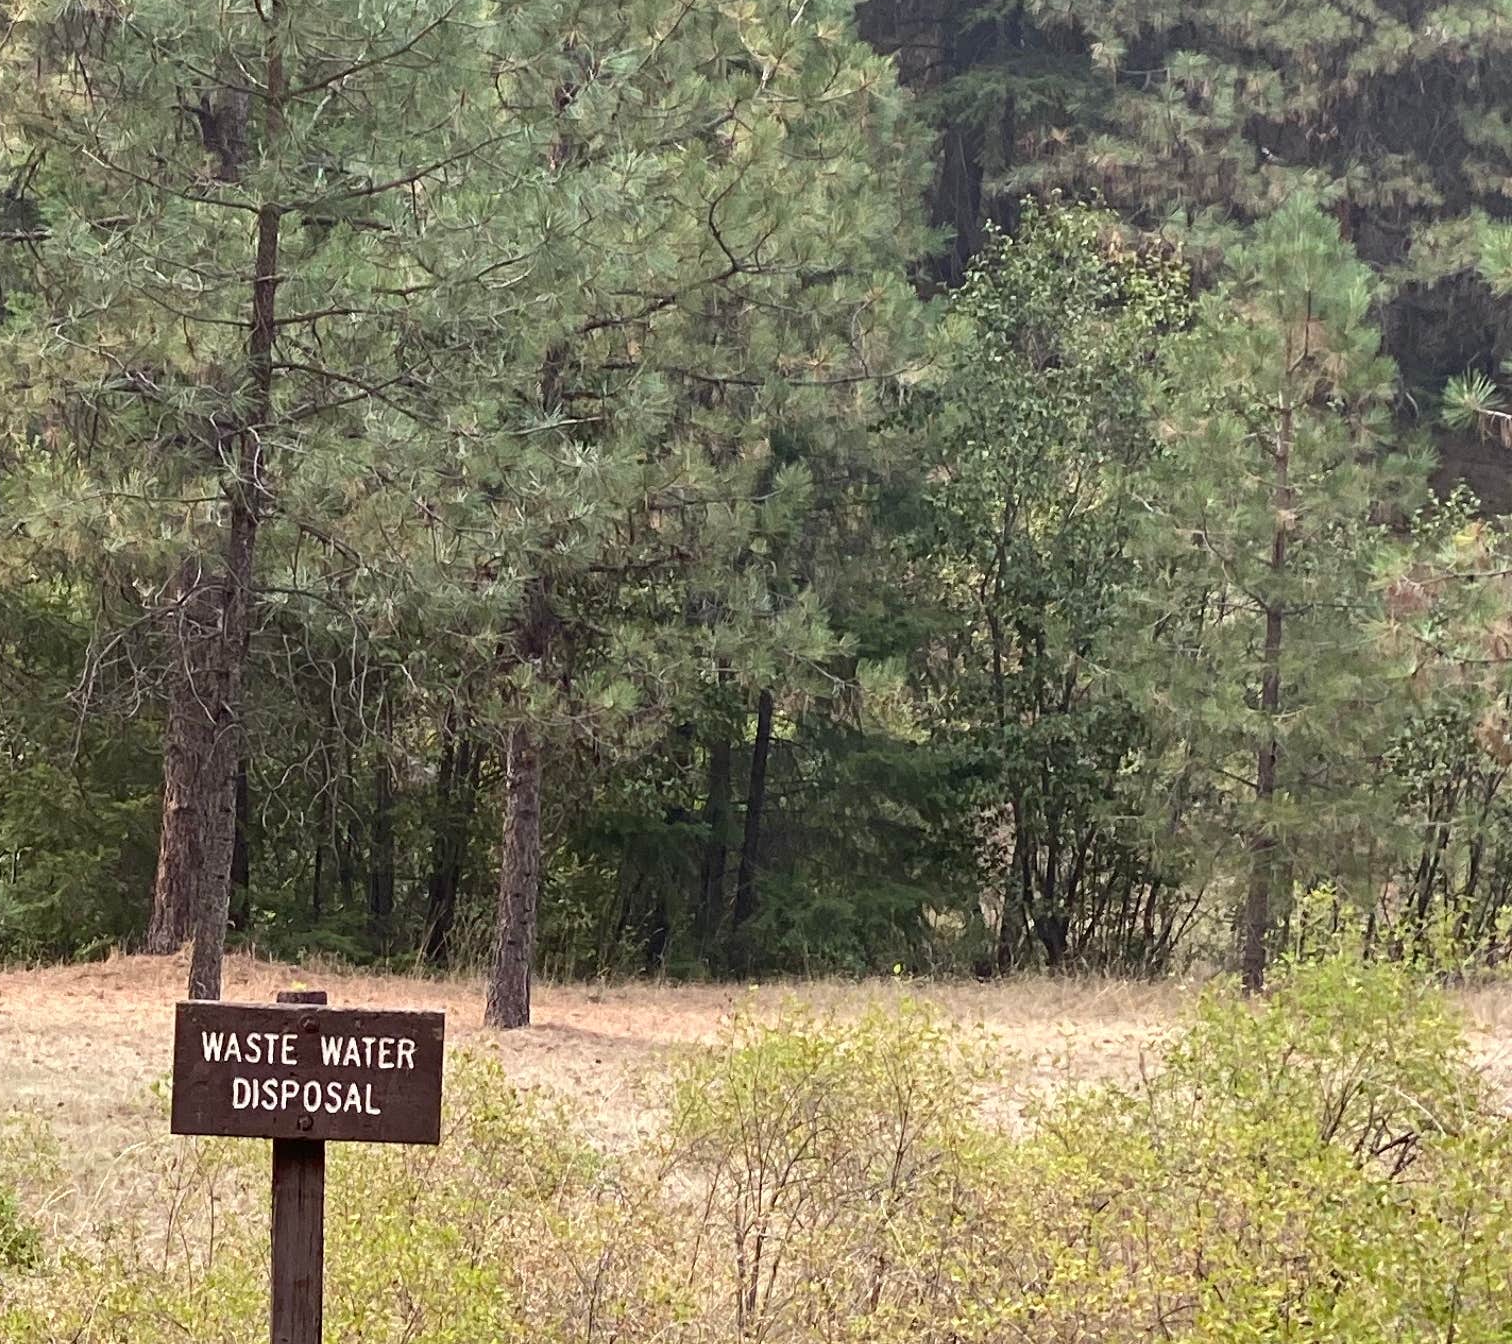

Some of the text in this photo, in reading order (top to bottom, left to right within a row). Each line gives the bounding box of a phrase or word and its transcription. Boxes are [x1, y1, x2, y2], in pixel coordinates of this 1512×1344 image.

[201, 1031, 416, 1070] WASTE WATER
[232, 1077, 381, 1116] DISPOSAL
